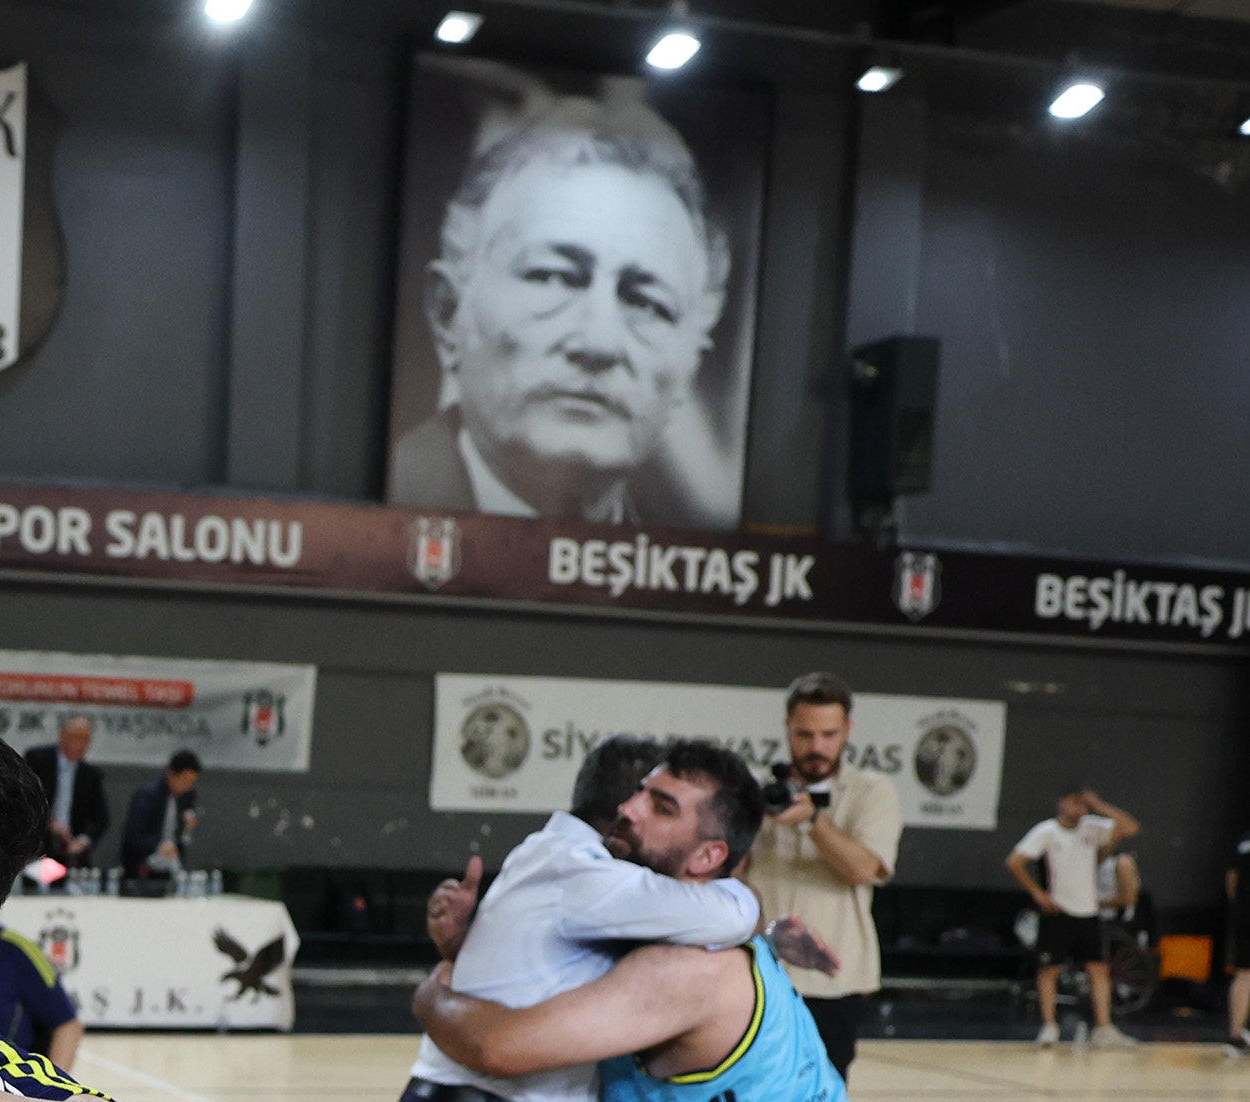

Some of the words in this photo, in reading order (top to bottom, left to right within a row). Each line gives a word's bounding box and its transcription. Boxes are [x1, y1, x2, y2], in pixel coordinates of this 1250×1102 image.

[105, 510, 303, 568] SALONU
[548, 533, 760, 606] BEŞİKTAŞ
[764, 553, 816, 607] JK
[1034, 569, 1224, 639] BEŞİKTAŞ
